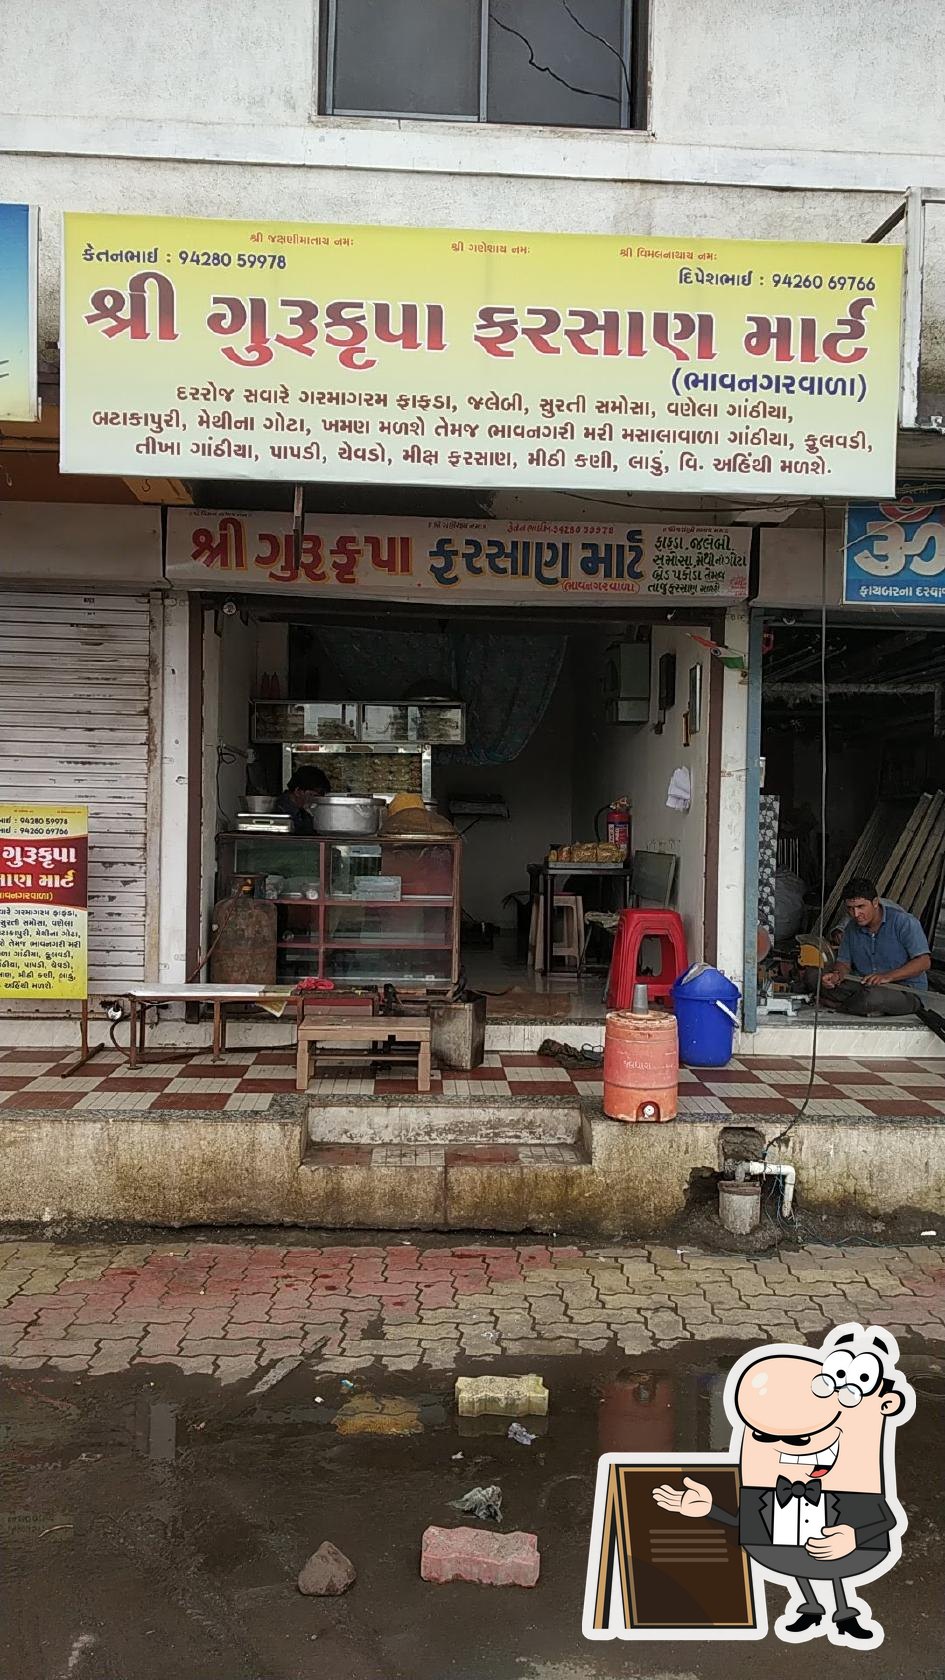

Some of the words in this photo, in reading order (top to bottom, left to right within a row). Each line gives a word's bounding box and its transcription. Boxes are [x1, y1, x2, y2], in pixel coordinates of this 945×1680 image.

[249, 233, 263, 243] શ્રી
[451, 242, 463, 252] શ્રી
[82, 243, 158, 264] કેતનભાઈ
[166, 253, 171, 263] :
[179, 250, 232, 267] 94280
[236, 252, 286, 270] 59978
[619, 248, 632, 258] શ્રી
[679, 266, 753, 288] દિપેશભાઈ
[759, 274, 765, 287] :
[772, 273, 823, 290] 94260
[828, 274, 876, 291] 69766
[84, 271, 179, 342] શ્રી
[206, 294, 447, 370] ગુરૂકૃપા
[473, 303, 719, 362] ફરસાણ
[743, 297, 878, 364] માર્ટ
[672, 367, 867, 402] (ભાવનગરવાળા)
[176, 381, 235, 403] દરરોજ
[243, 384, 289, 405] સવારે
[298, 390, 388, 408] ગરમાગરમ
[396, 394, 457, 413] ફાફડા,
[539, 395, 586, 418] સુરતી
[595, 395, 656, 418] સમોસા,
[667, 396, 718, 418] વણેલા
[92, 409, 187, 434] બટાકાપુરી,
[197, 409, 255, 431] મેથીના
[263, 412, 311, 436] ગોટા,
[322, 417, 369, 433] ખમણ
[378, 416, 425, 437] મળશે
[434, 417, 479, 438] તેમજ
[487, 421, 575, 440] ભાવનગરી
[583, 422, 613, 442] મરી
[621, 426, 719, 445] મસાલાવાળા
[135, 436, 180, 456] તીખા
[270, 442, 327, 464] પાપડી,
[338, 441, 392, 465] ચેવડો,
[448, 449, 517, 469] ફરસાણ,
[528, 448, 565, 467] મીઠી
[575, 452, 618, 472] કણી,
[190, 517, 246, 569] શ્રી
[428, 538, 571, 587] ફરસાણ
[580, 529, 645, 580] માર્ટ
[3, 847, 77, 868] ગુરૂકૃપા
[39, 869, 76, 888] માર્ટ
